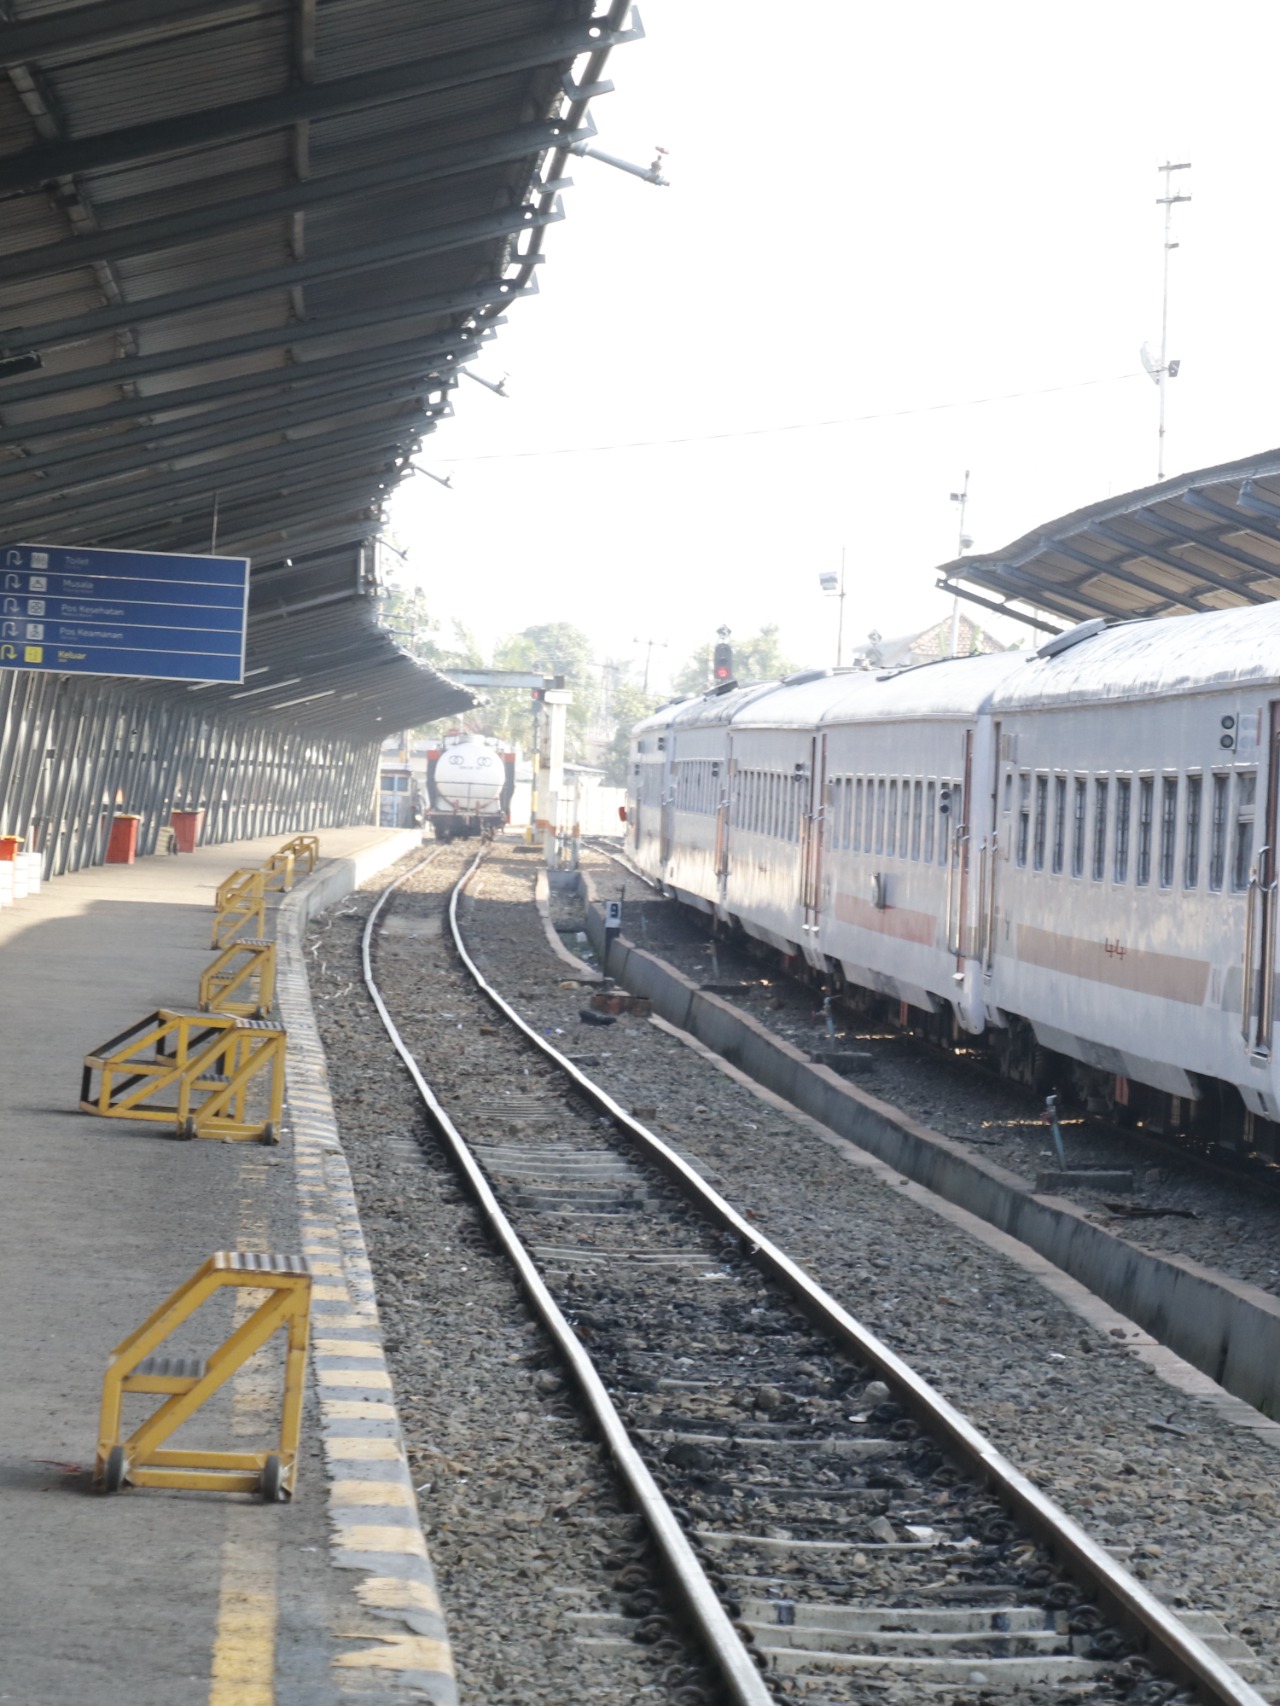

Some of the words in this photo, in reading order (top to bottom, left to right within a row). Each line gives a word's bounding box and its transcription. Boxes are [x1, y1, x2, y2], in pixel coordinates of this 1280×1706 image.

[61, 604, 77, 613] Pos
[79, 605, 125, 616] Kesehatan
[60, 626, 76, 636] Pos
[77, 628, 123, 639] Keamanan
[57, 651, 87, 660] Keluar
